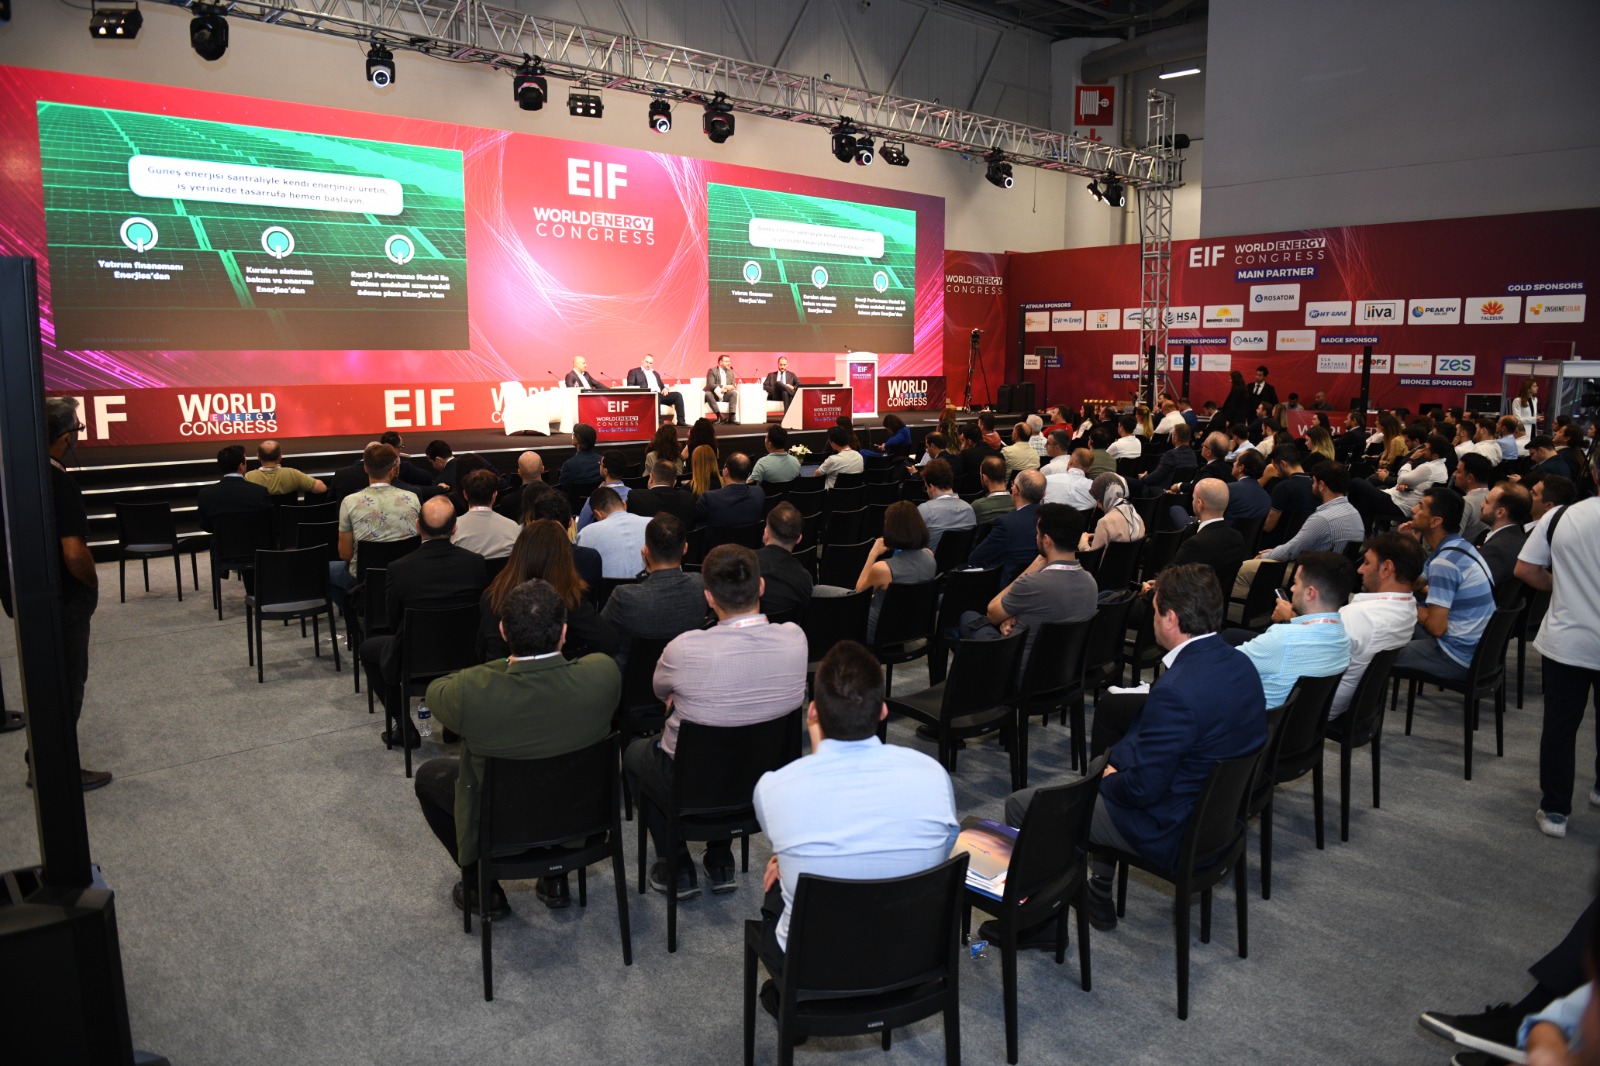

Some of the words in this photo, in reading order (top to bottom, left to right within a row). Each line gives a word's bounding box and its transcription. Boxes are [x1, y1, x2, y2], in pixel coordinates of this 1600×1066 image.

[567, 158, 628, 200] EIF
[533, 206, 591, 224] WORLD
[592, 212, 653, 231] ENERGY
[536, 223, 654, 245] CONGRESS
[1234, 242, 1274, 253] WORLD
[1276, 238, 1325, 250] ENERGY
[1189, 245, 1225, 268] EIF
[1235, 250, 1324, 265] CONGRESS
[946, 275, 972, 284] WORLD
[973, 276, 1002, 285] ENERGY
[1238, 270, 1264, 279] MAIN
[1266, 267, 1314, 278] PARTNER
[946, 285, 1003, 295] CONGRESS
[1177, 312, 1197, 320] HSA
[888, 380, 928, 398] WORLD
[608, 401, 629, 412] EIF
[821, 394, 835, 404] EIF
[888, 397, 928, 406] CONGRESS
[178, 393, 276, 422] WORLD
[384, 388, 456, 428] EIF
[210, 413, 276, 421] ENERGY
[180, 420, 278, 436] CONGRESS
